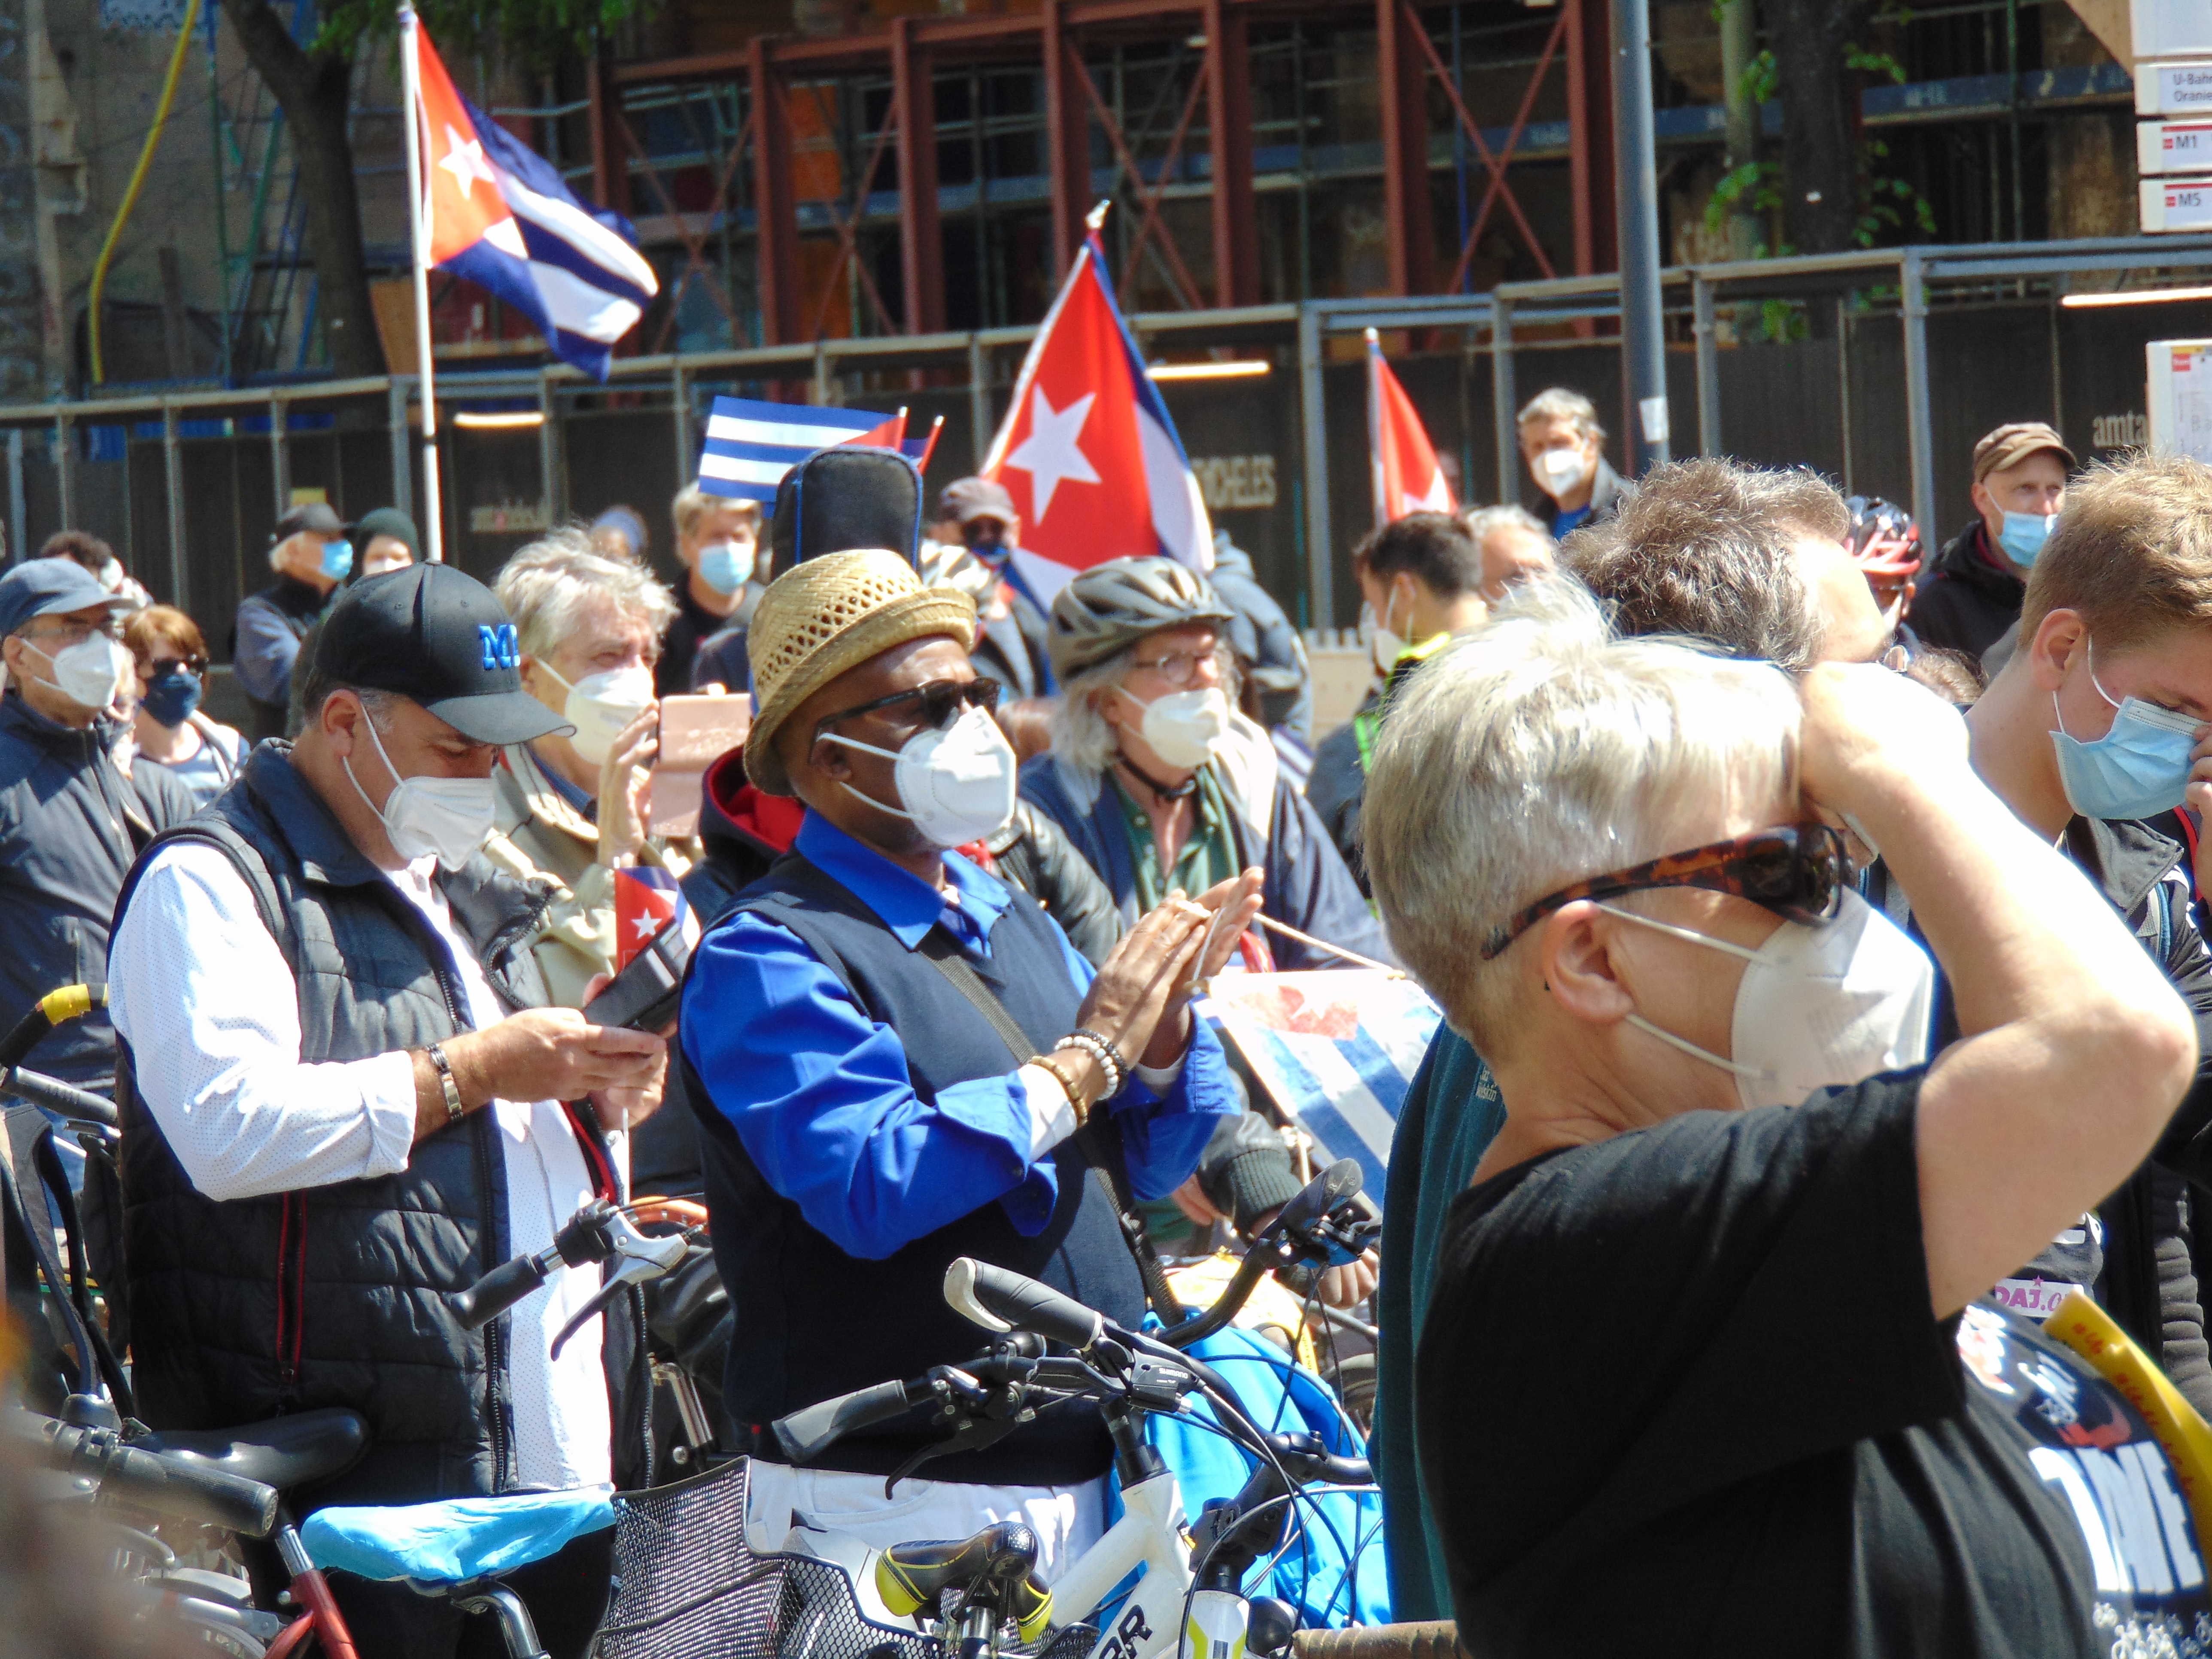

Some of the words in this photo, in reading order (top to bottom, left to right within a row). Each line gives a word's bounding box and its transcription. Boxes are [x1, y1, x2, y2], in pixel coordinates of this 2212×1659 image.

[2176, 135, 2198, 149] M1
[2179, 193, 2201, 207] M5
[1159, 1367, 1188, 1379] SHIMANO
